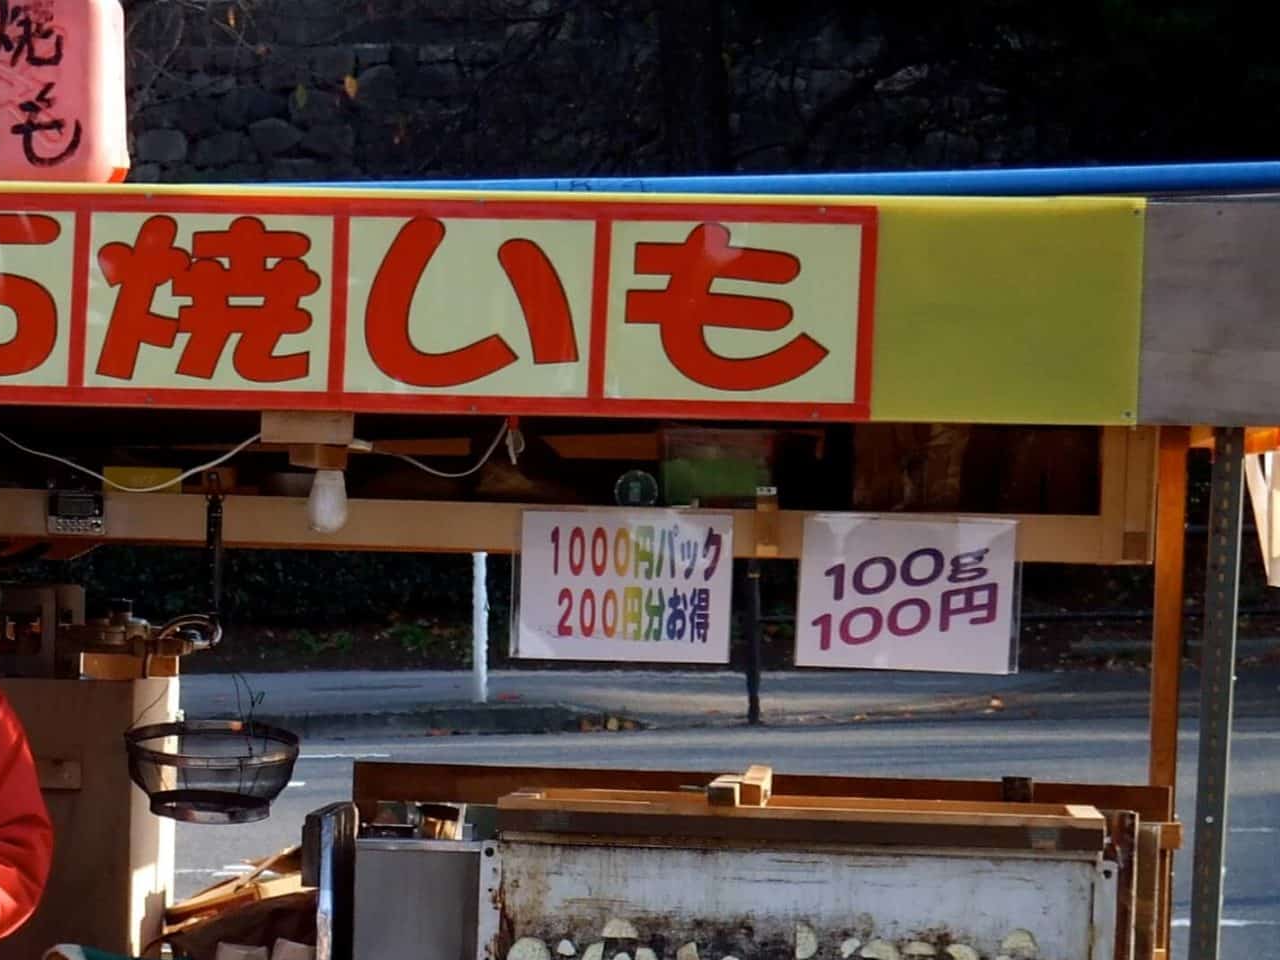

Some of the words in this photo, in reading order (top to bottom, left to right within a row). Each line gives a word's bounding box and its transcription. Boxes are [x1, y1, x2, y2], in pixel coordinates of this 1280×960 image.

[550, 524, 723, 582] 1000円パック
[823, 547, 990, 601] 100g
[557, 586, 711, 644] 200円分お得
[810, 582, 999, 651] 100円
